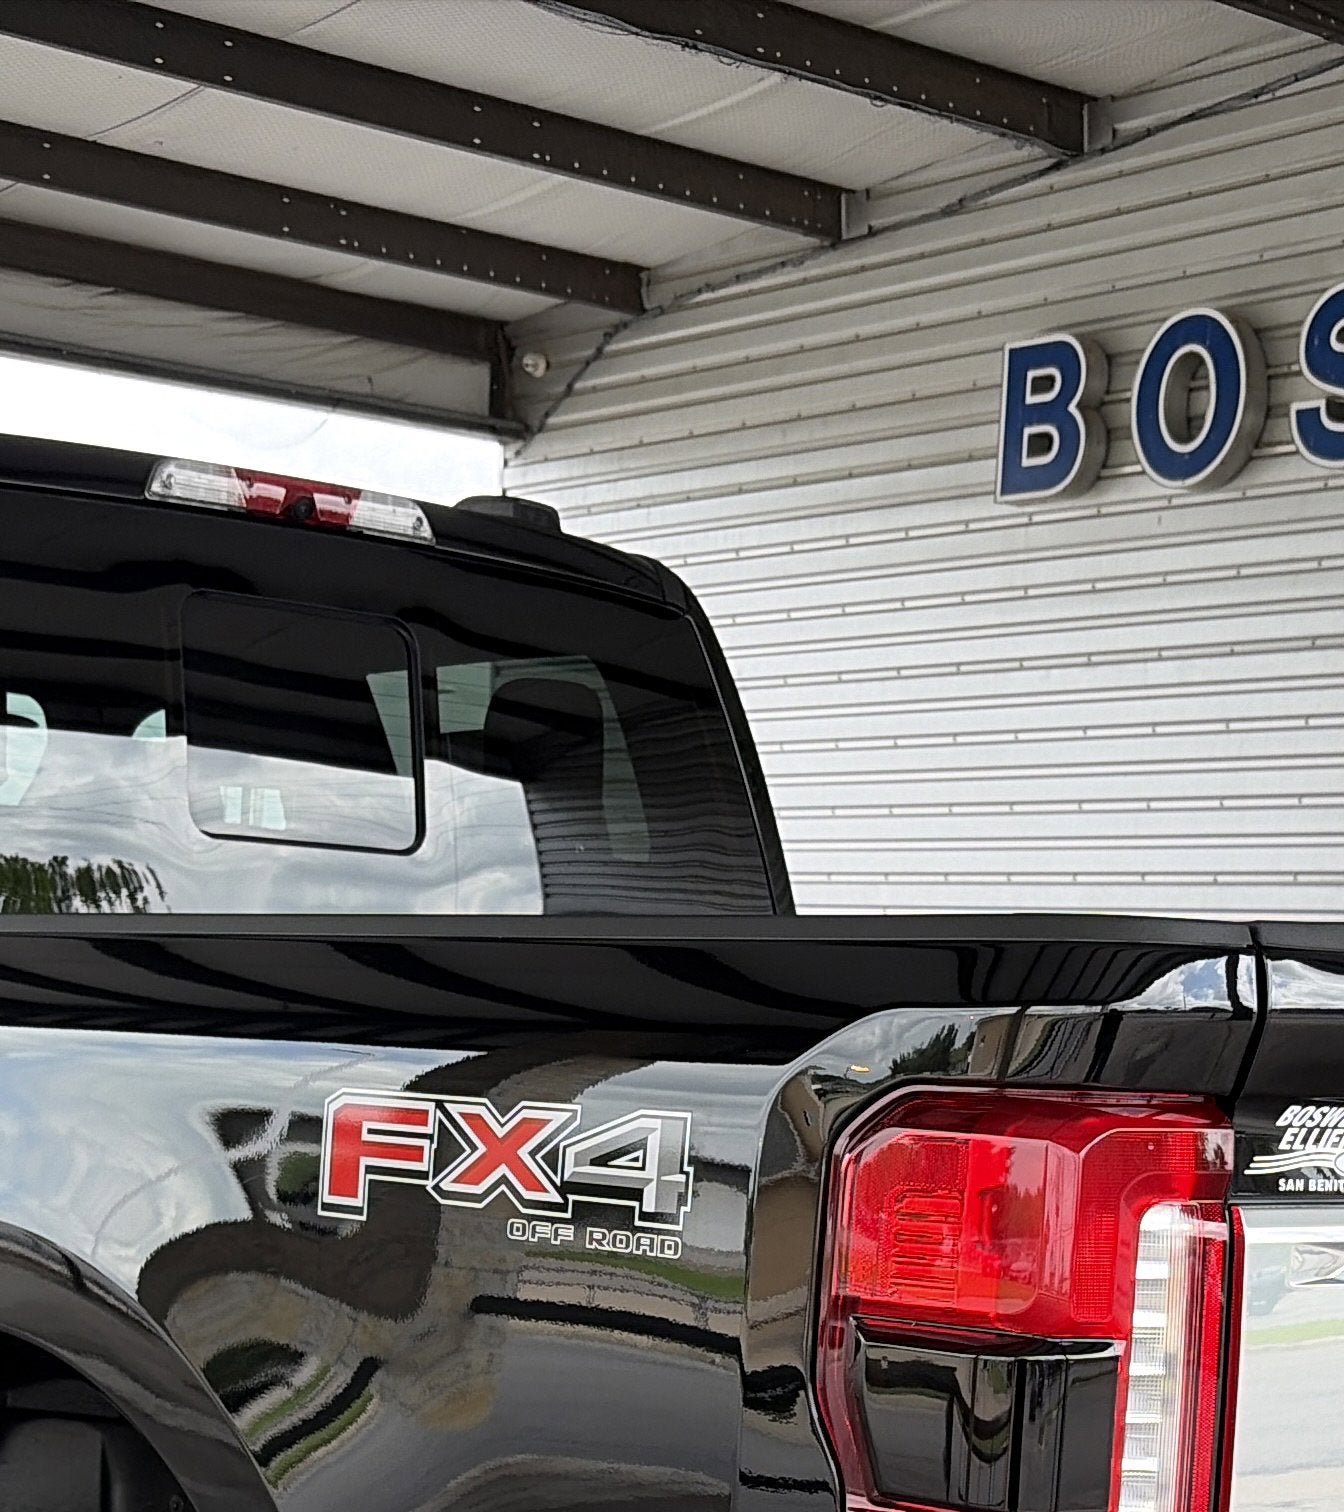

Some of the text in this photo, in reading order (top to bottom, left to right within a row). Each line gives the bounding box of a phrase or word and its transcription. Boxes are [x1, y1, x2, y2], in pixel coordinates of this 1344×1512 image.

[318, 1088, 692, 1230] FX4
[1278, 1178, 1304, 1192] SAN
[507, 1218, 682, 1260] OFF ROAD
